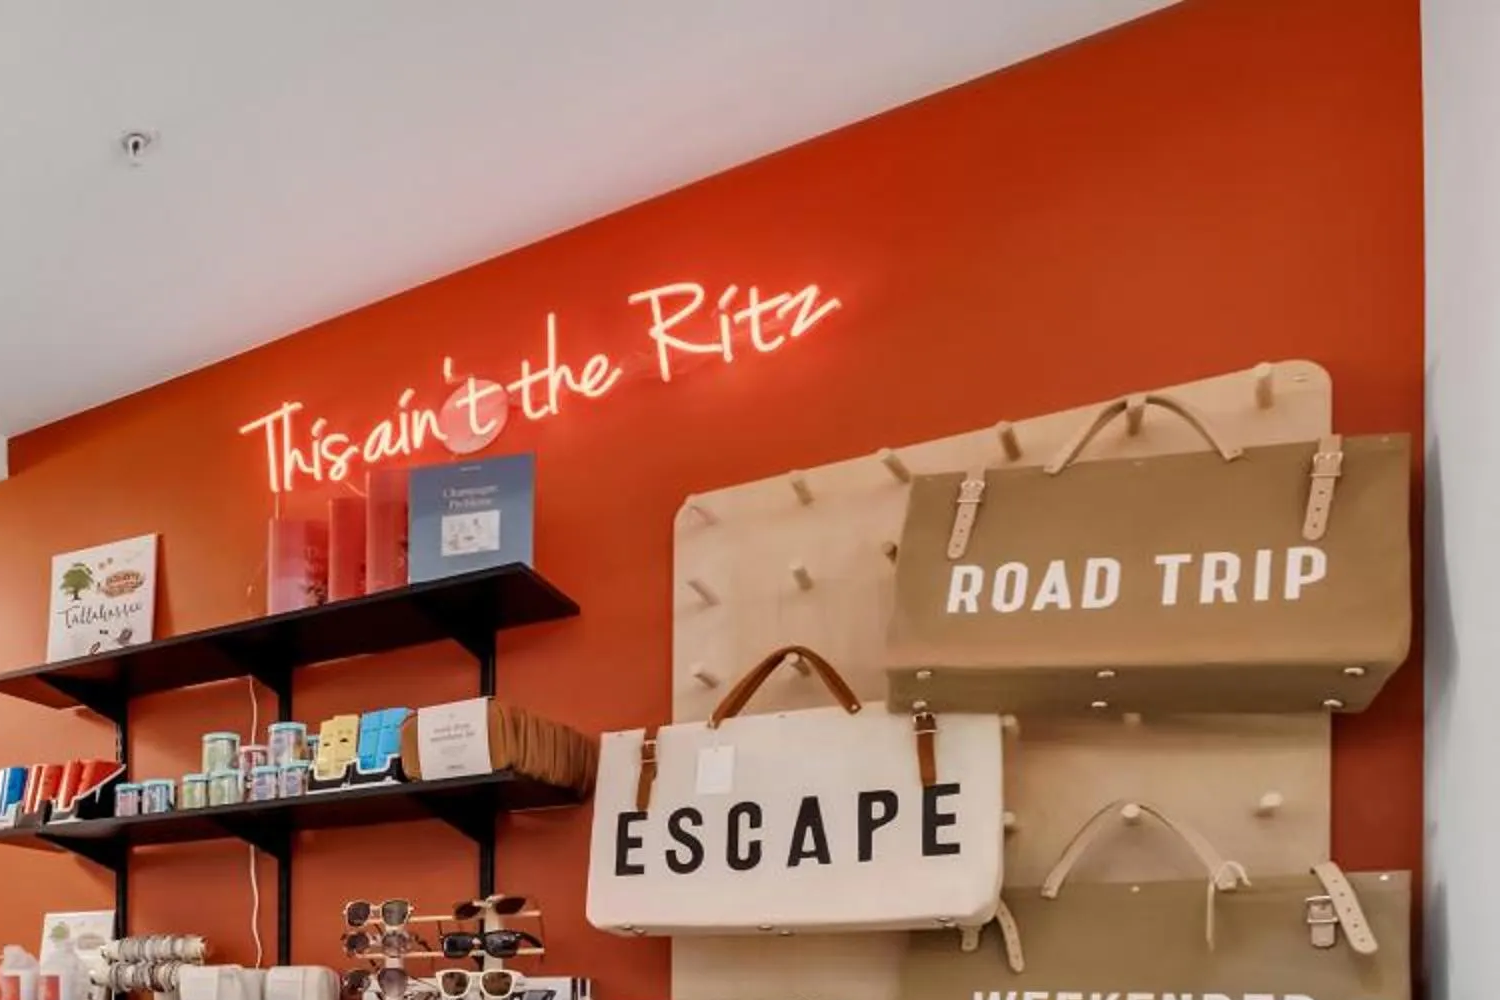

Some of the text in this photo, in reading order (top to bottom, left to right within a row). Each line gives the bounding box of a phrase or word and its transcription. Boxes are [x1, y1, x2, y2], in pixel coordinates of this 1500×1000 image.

[239, 282, 842, 493] This ain't the Ritz
[945, 546, 1328, 615] ROAD TRIP
[613, 782, 962, 877] ESCAPE
